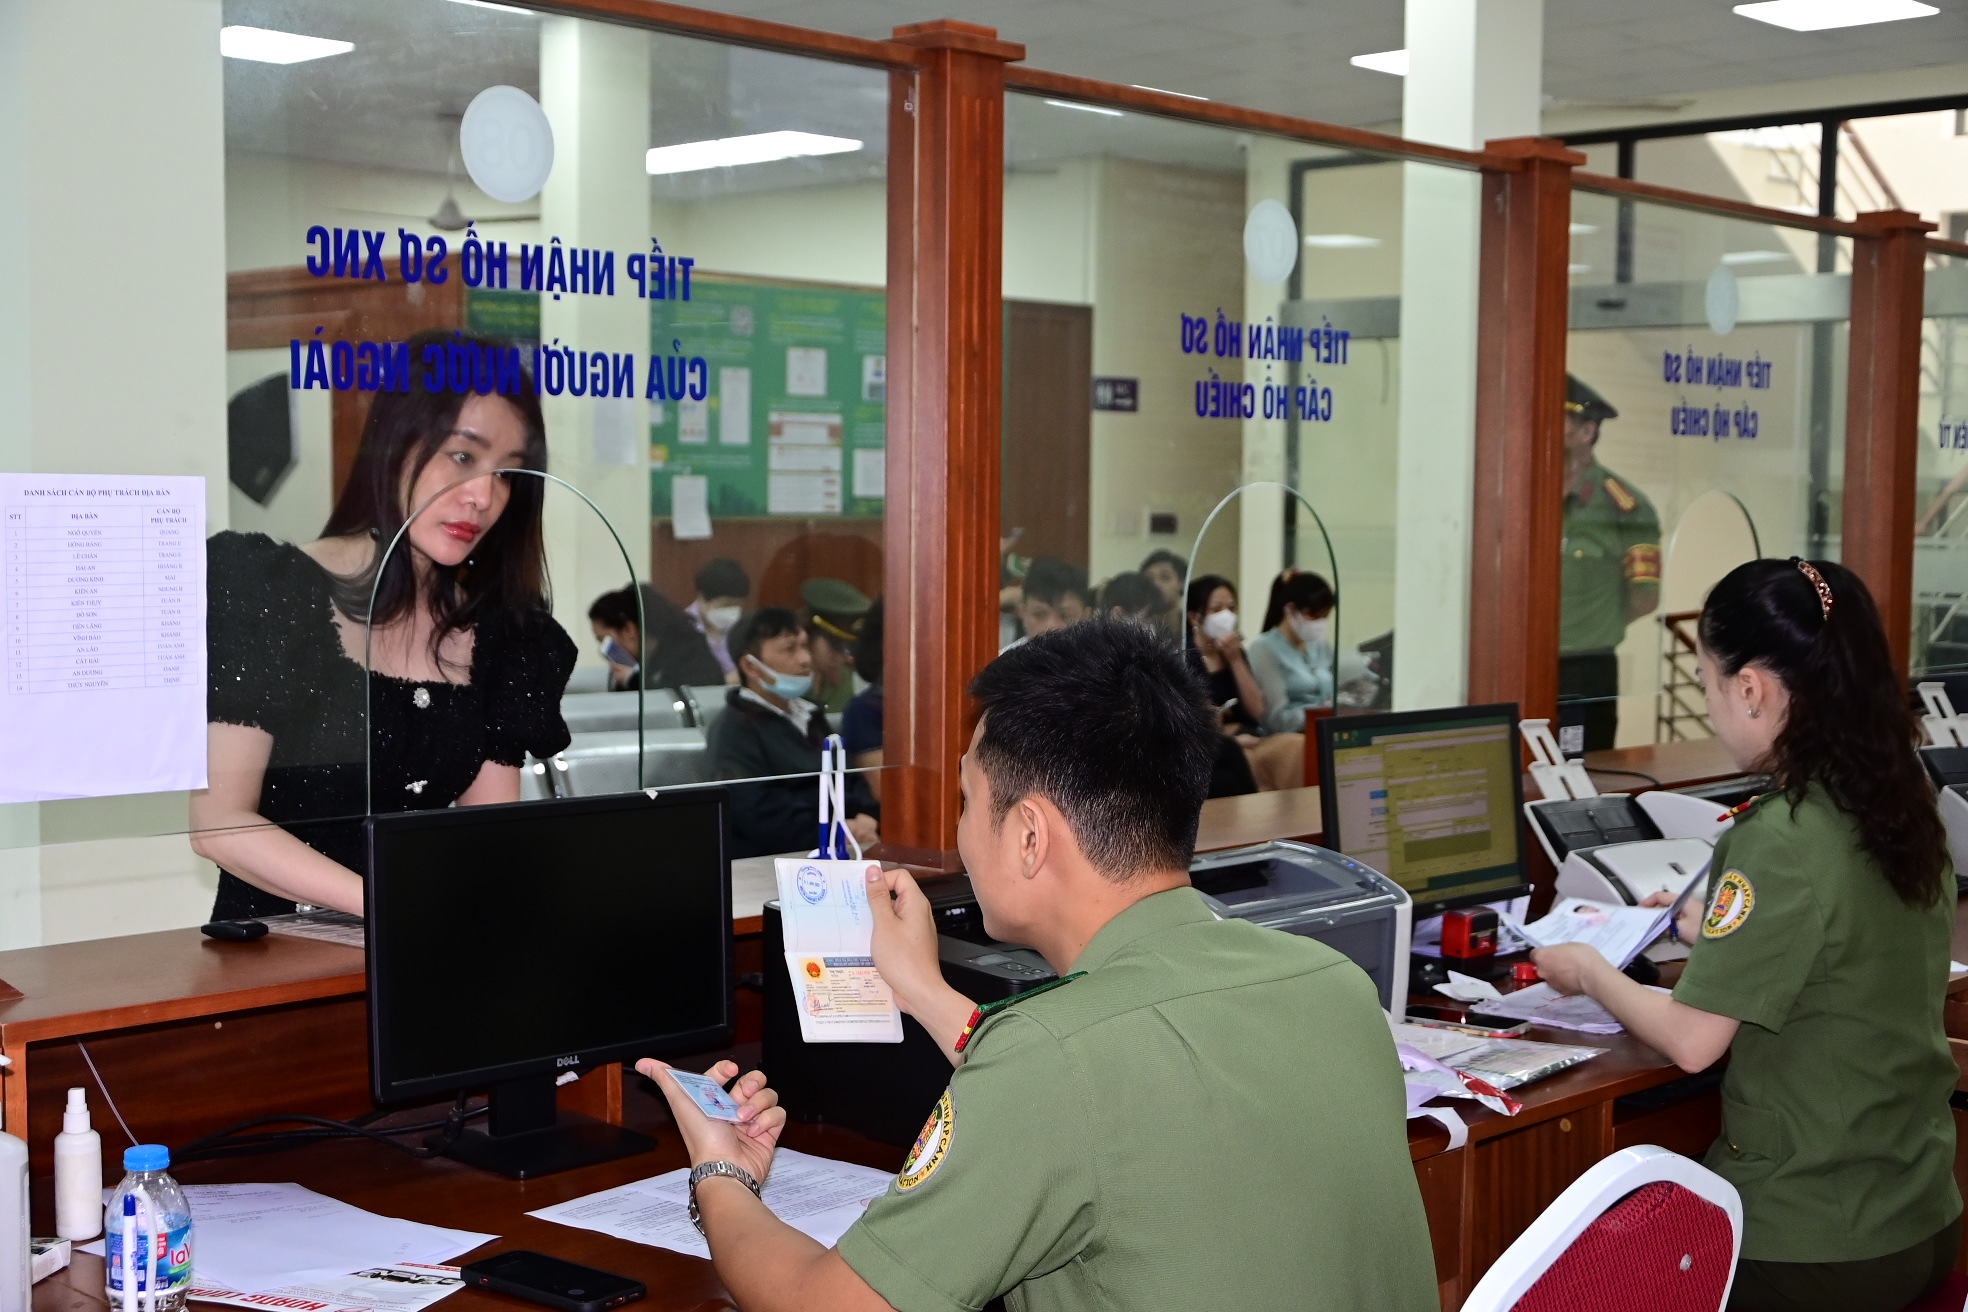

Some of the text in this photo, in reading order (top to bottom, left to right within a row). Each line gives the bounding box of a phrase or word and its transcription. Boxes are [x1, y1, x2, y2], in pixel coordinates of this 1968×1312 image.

[46, 488, 67, 496] SÁCH
[68, 488, 84, 496] CÁN
[114, 488, 140, 496] TRÁCH
[556, 1054, 580, 1068] DELL
